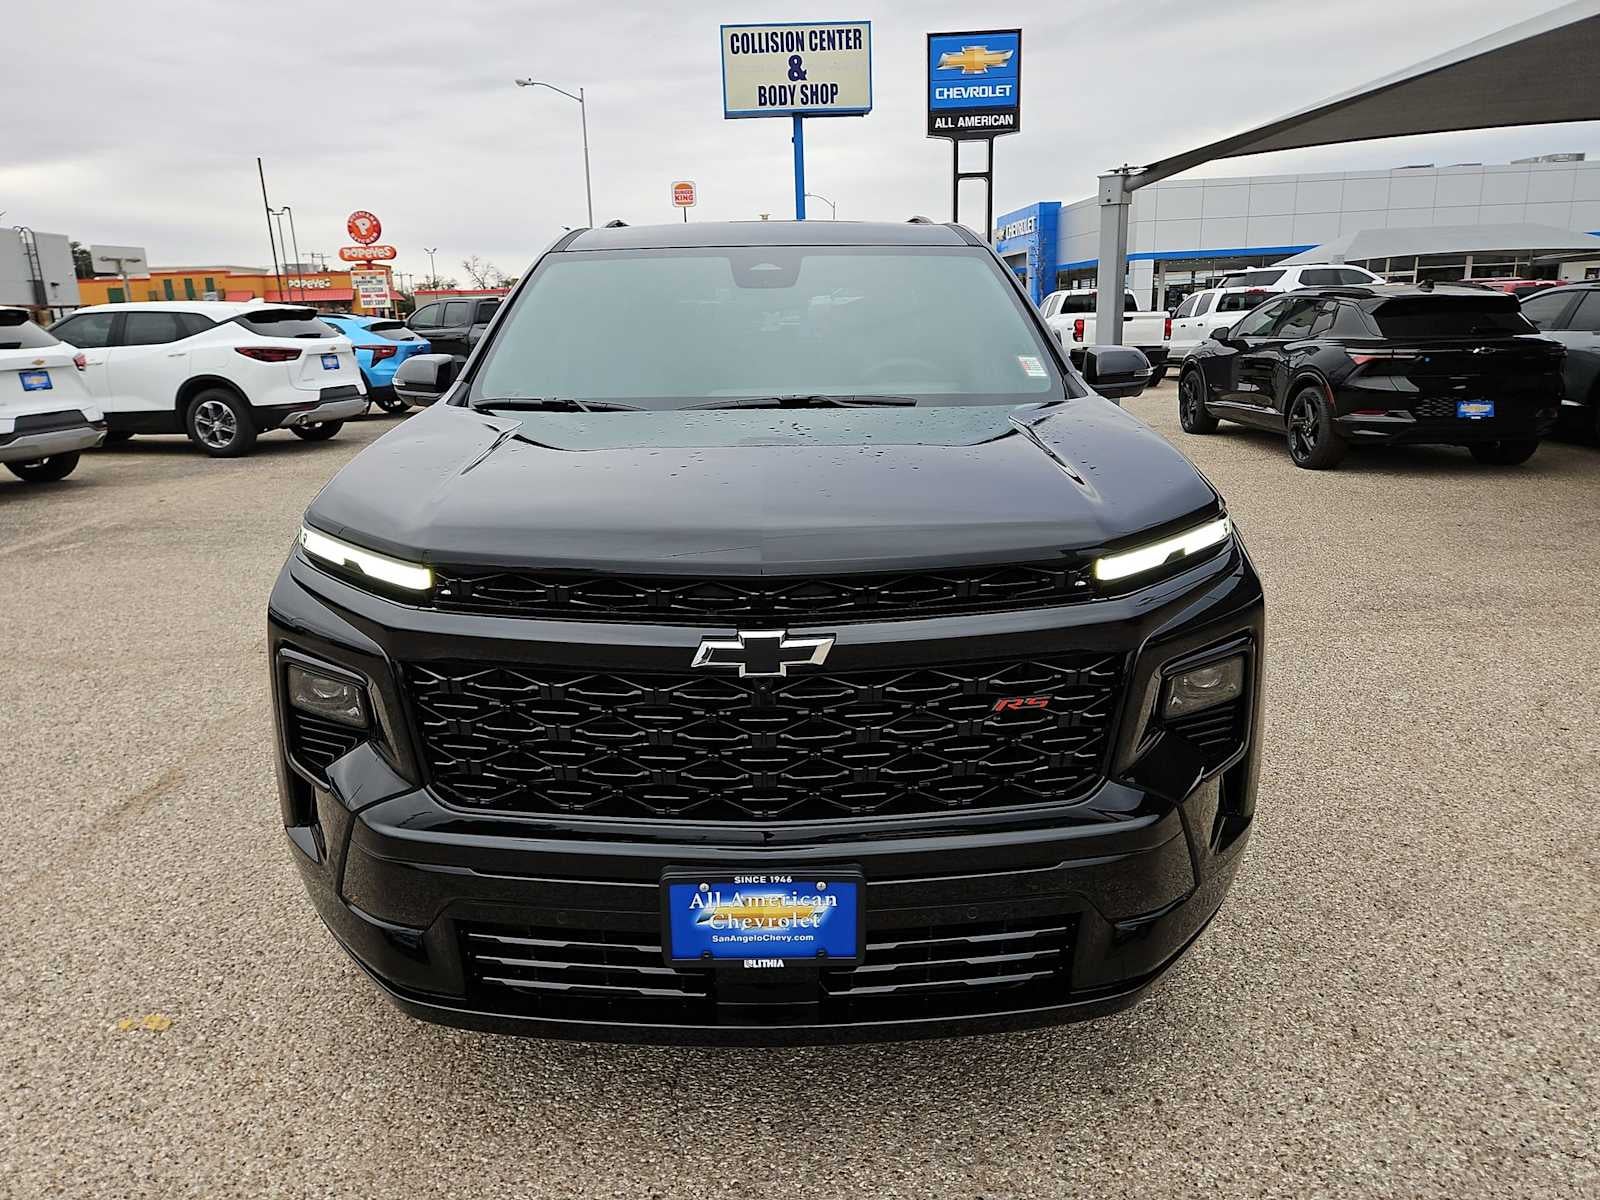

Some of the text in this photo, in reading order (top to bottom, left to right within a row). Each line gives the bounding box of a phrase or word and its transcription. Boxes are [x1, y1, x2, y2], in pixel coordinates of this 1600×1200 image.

[730, 28, 863, 54] COLLISION CENTER
[787, 54, 808, 81] &
[757, 83, 839, 106] BODY SHOP
[935, 84, 1012, 100] CHEVROLET
[934, 114, 1014, 128] ALL AMERICAN
[1005, 216, 1037, 239] CHEVROLET
[992, 696, 1050, 711] RS
[734, 876, 766, 884] SINCE
[689, 891, 838, 909] All American
[710, 913, 821, 931] Chevrolet
[712, 934, 814, 944] SanAngeloChevy.com
[752, 959, 785, 968] LITHIA
